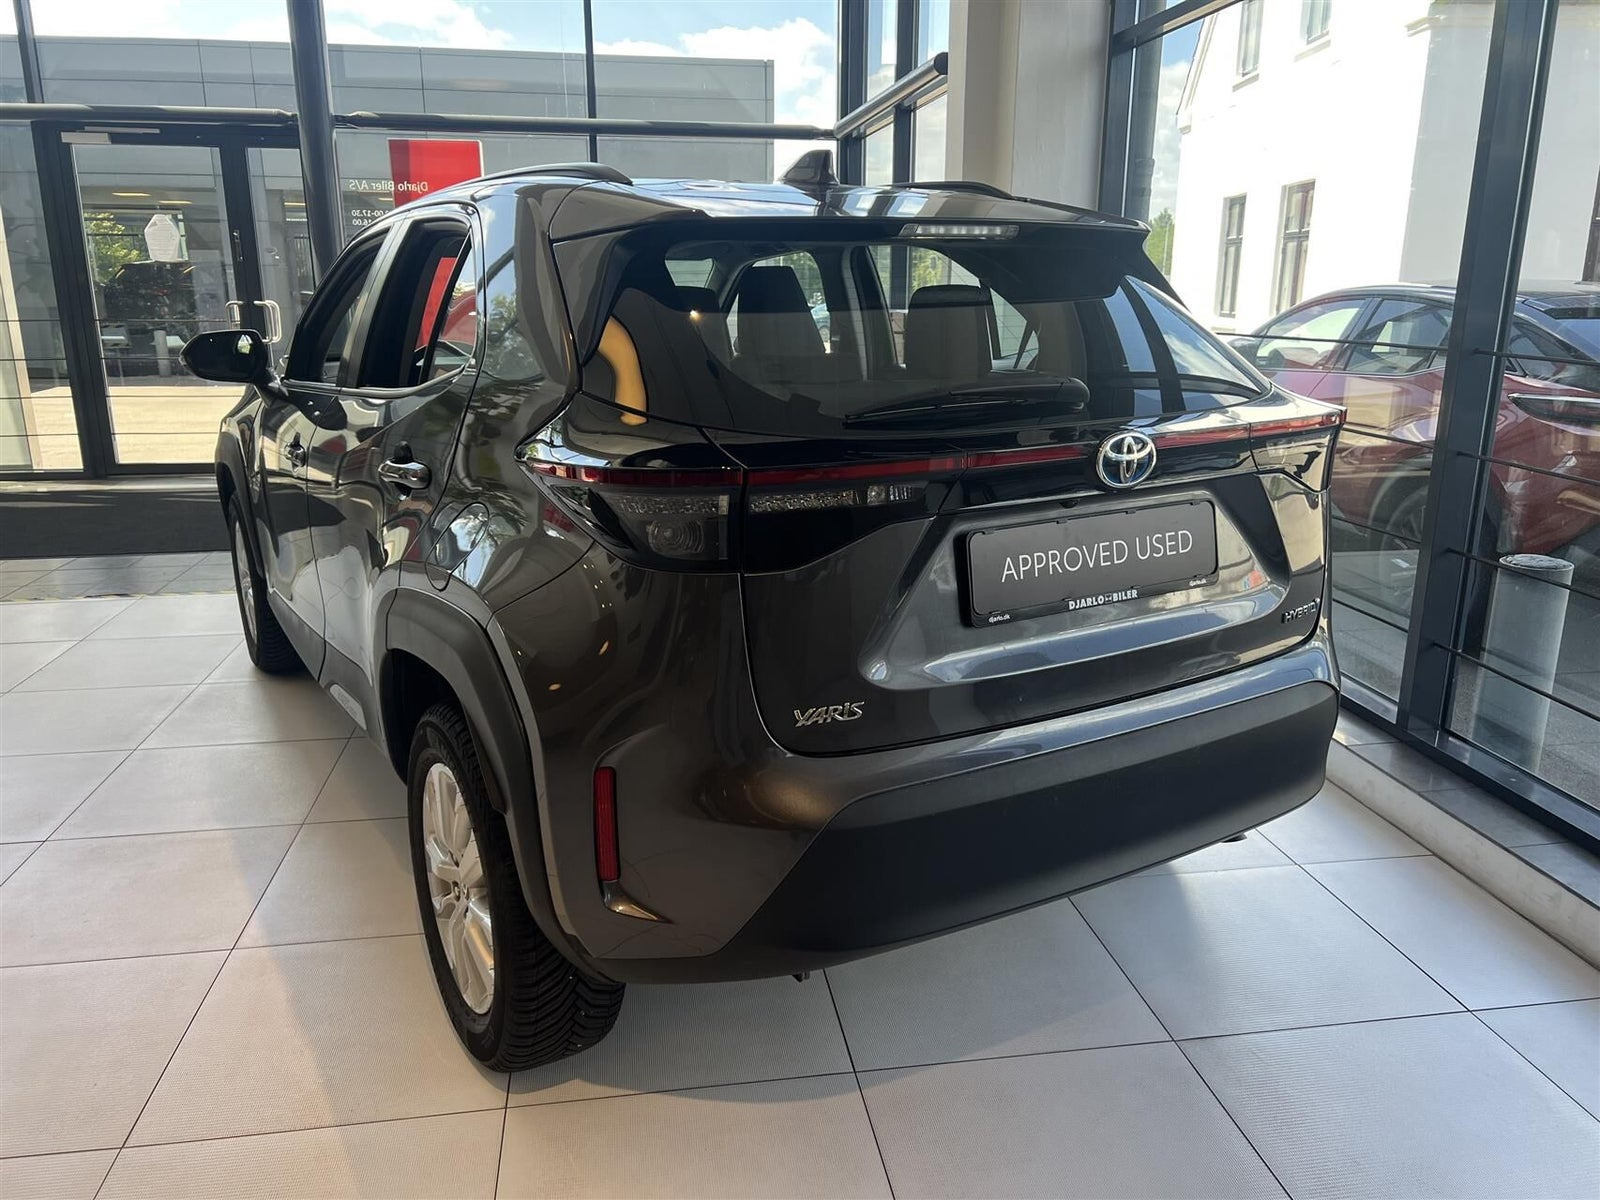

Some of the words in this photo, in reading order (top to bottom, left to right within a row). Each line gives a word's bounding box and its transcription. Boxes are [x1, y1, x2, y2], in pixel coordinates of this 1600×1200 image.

[1001, 540, 1129, 583] APPROVED
[1135, 529, 1194, 560] USED
[1068, 595, 1105, 611] DJARLO
[1112, 589, 1139, 602] BILER
[1281, 600, 1317, 624] HYBRID
[793, 701, 865, 728] YARIS
